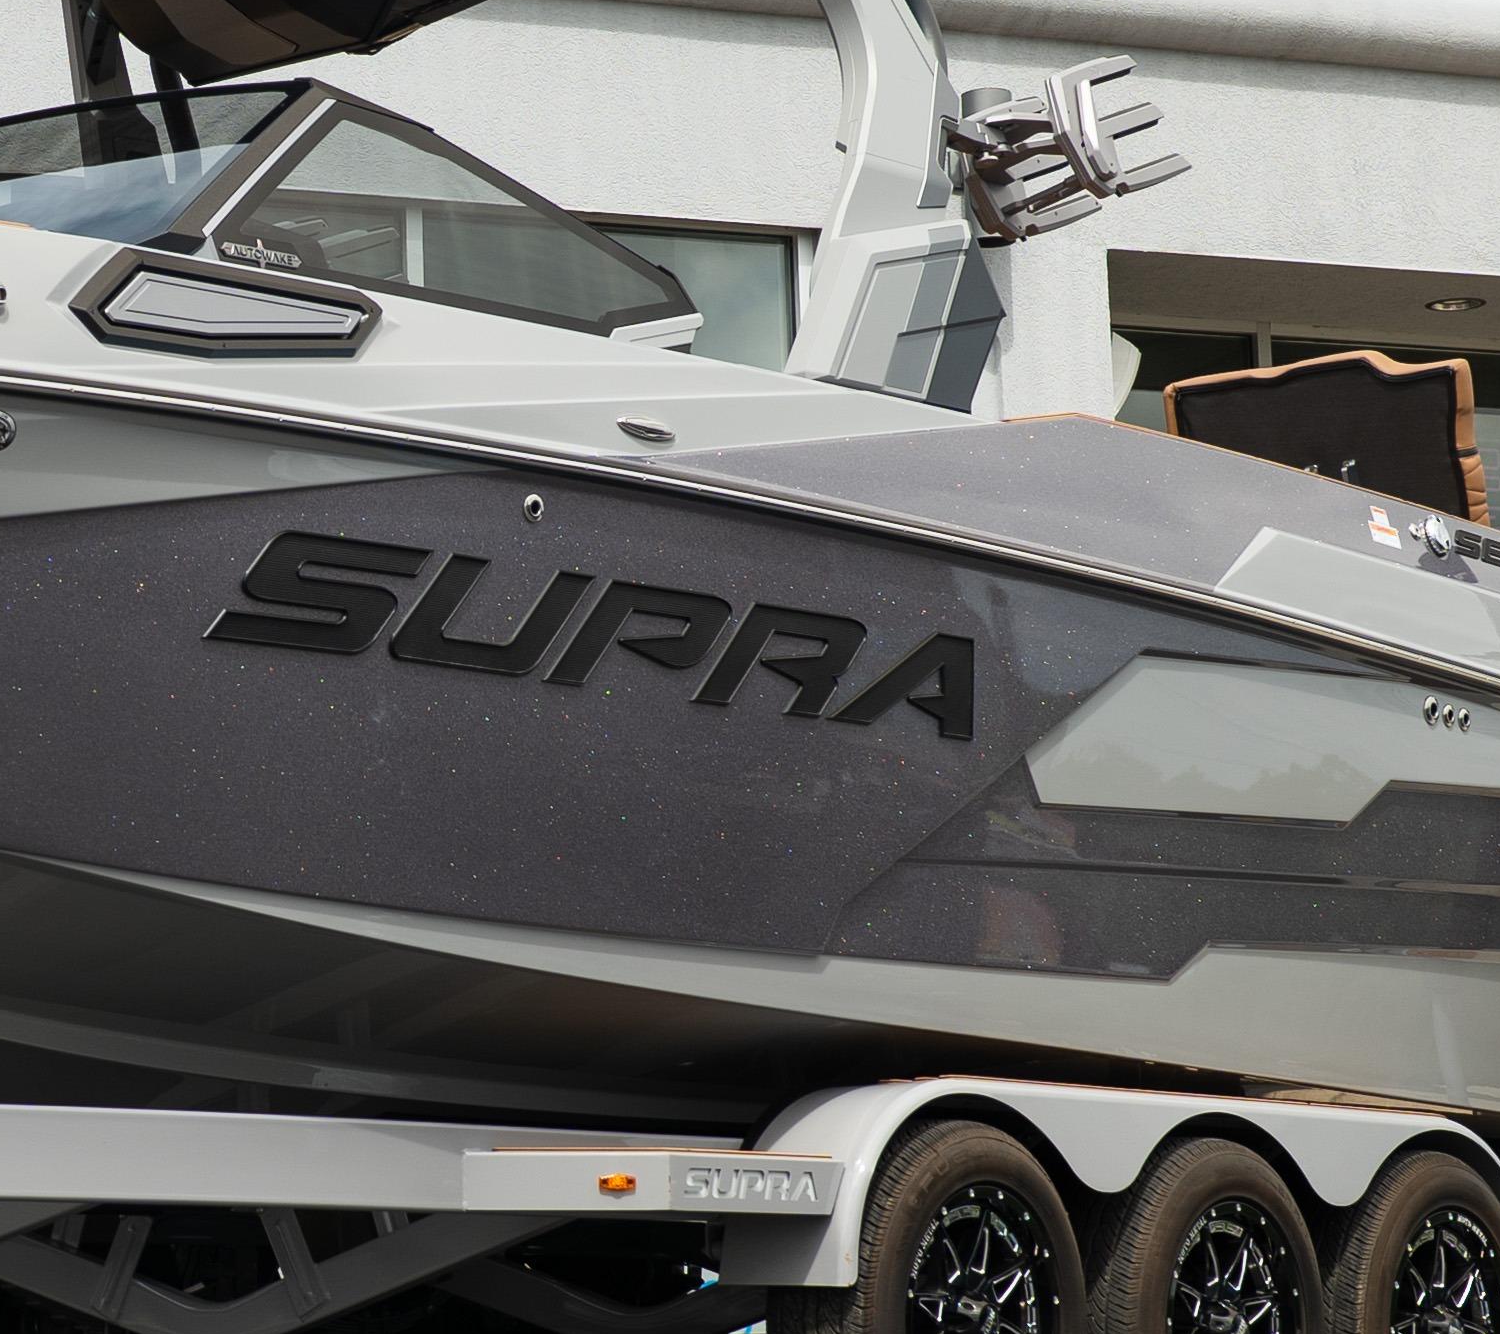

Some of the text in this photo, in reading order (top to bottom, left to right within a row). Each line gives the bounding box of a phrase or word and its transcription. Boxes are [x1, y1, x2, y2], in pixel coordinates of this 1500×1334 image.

[231, 244, 294, 266] AUTOWAKE
[202, 528, 976, 742] SUPRA
[683, 1167, 819, 1203] SUPRA
